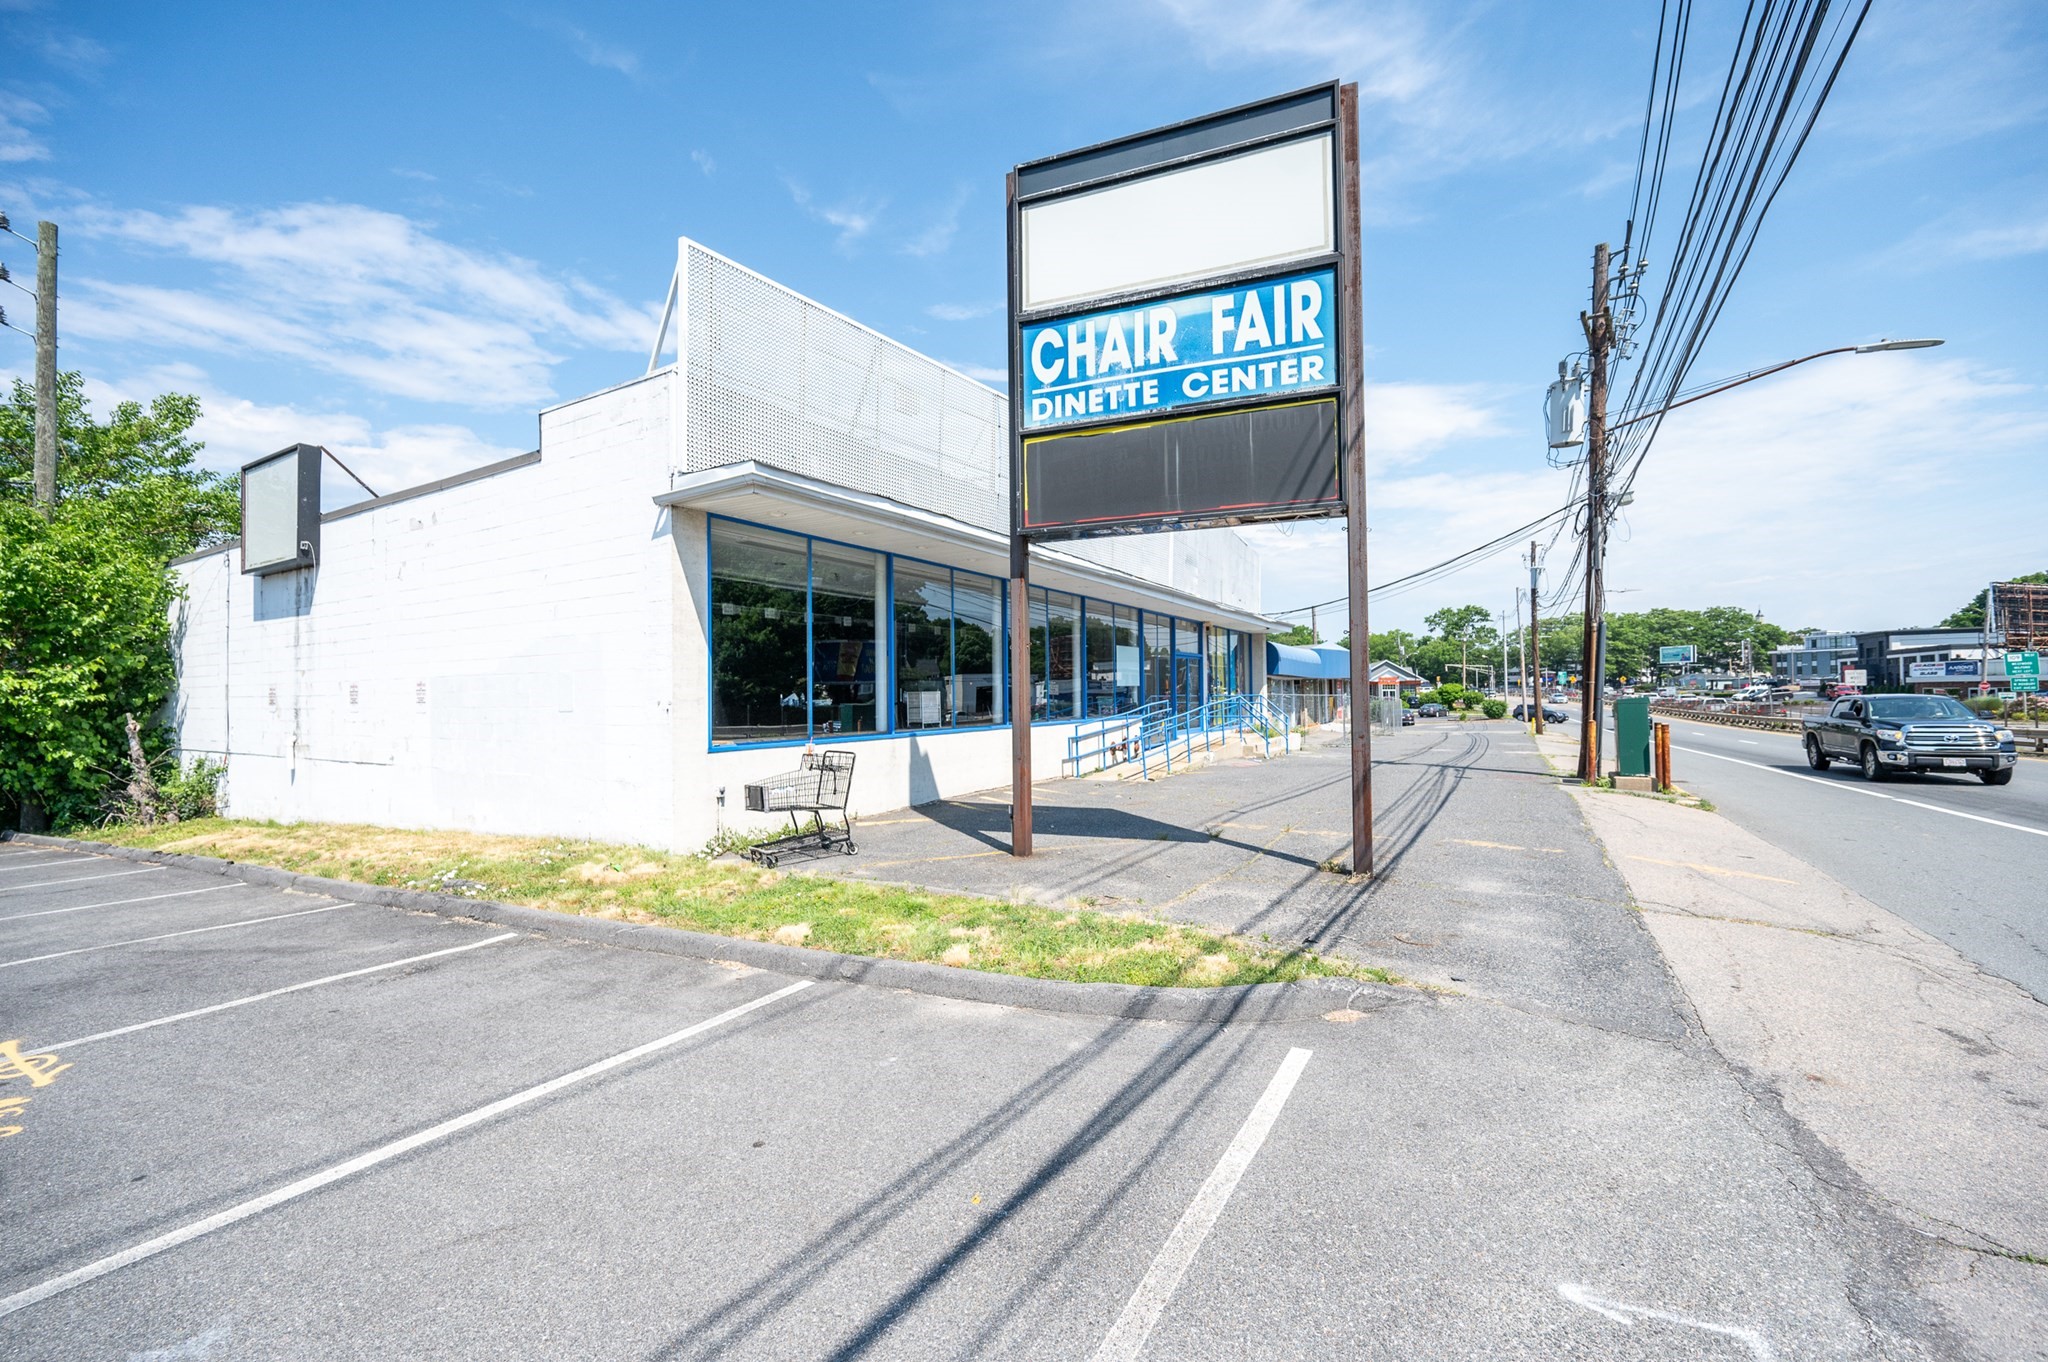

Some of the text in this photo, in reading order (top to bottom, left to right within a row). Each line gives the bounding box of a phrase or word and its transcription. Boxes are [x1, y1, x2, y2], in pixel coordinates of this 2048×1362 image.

[1031, 279, 1324, 384] CHAIR FAIR
[1031, 355, 1325, 421] DINETTE CENTER
